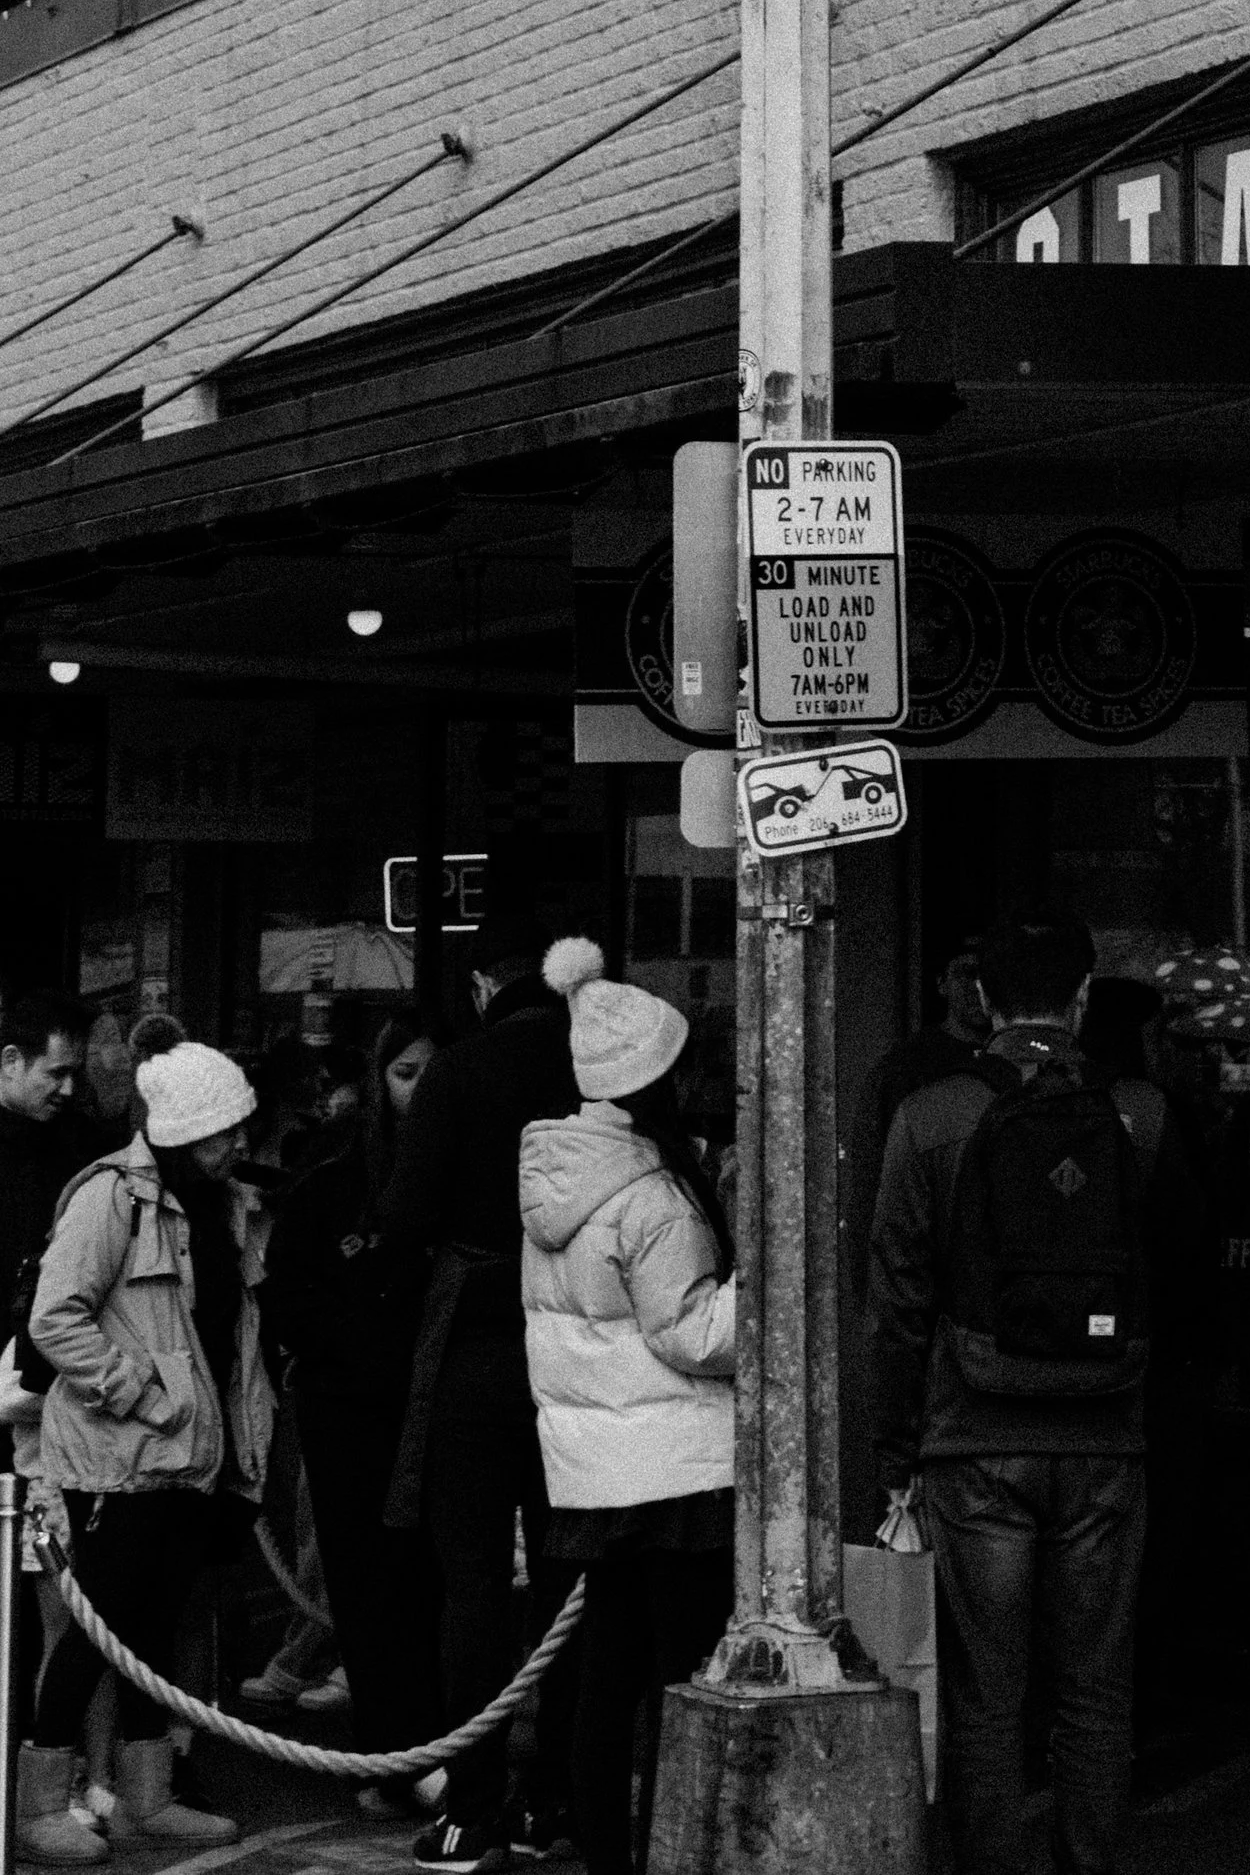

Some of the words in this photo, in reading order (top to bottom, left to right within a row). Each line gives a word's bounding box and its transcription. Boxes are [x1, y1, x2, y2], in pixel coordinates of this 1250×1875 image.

[755, 458, 785, 484] NO
[802, 460, 877, 483] PARKING
[777, 496, 824, 522] 2-7
[836, 496, 871, 522] AM
[783, 527, 866, 545] EVERYDAY
[758, 560, 788, 585] 30
[808, 565, 881, 587] MINUTE
[1056, 550, 1161, 589] STARBUCKS
[779, 596, 830, 618] LOAD
[839, 595, 875, 618] AND
[790, 621, 867, 644] UNLOAD
[803, 646, 856, 668] ONLY
[791, 672, 870, 696] 7AM-6PM
[946, 656, 997, 718] SPICES
[1037, 653, 1092, 722] COFFEE
[1102, 704, 1138, 726] TEA
[1139, 655, 1188, 717] SPICES
[796, 699, 866, 715] EVERDAY
[764, 824, 800, 839] Phone
[809, 817, 829, 832] 206
